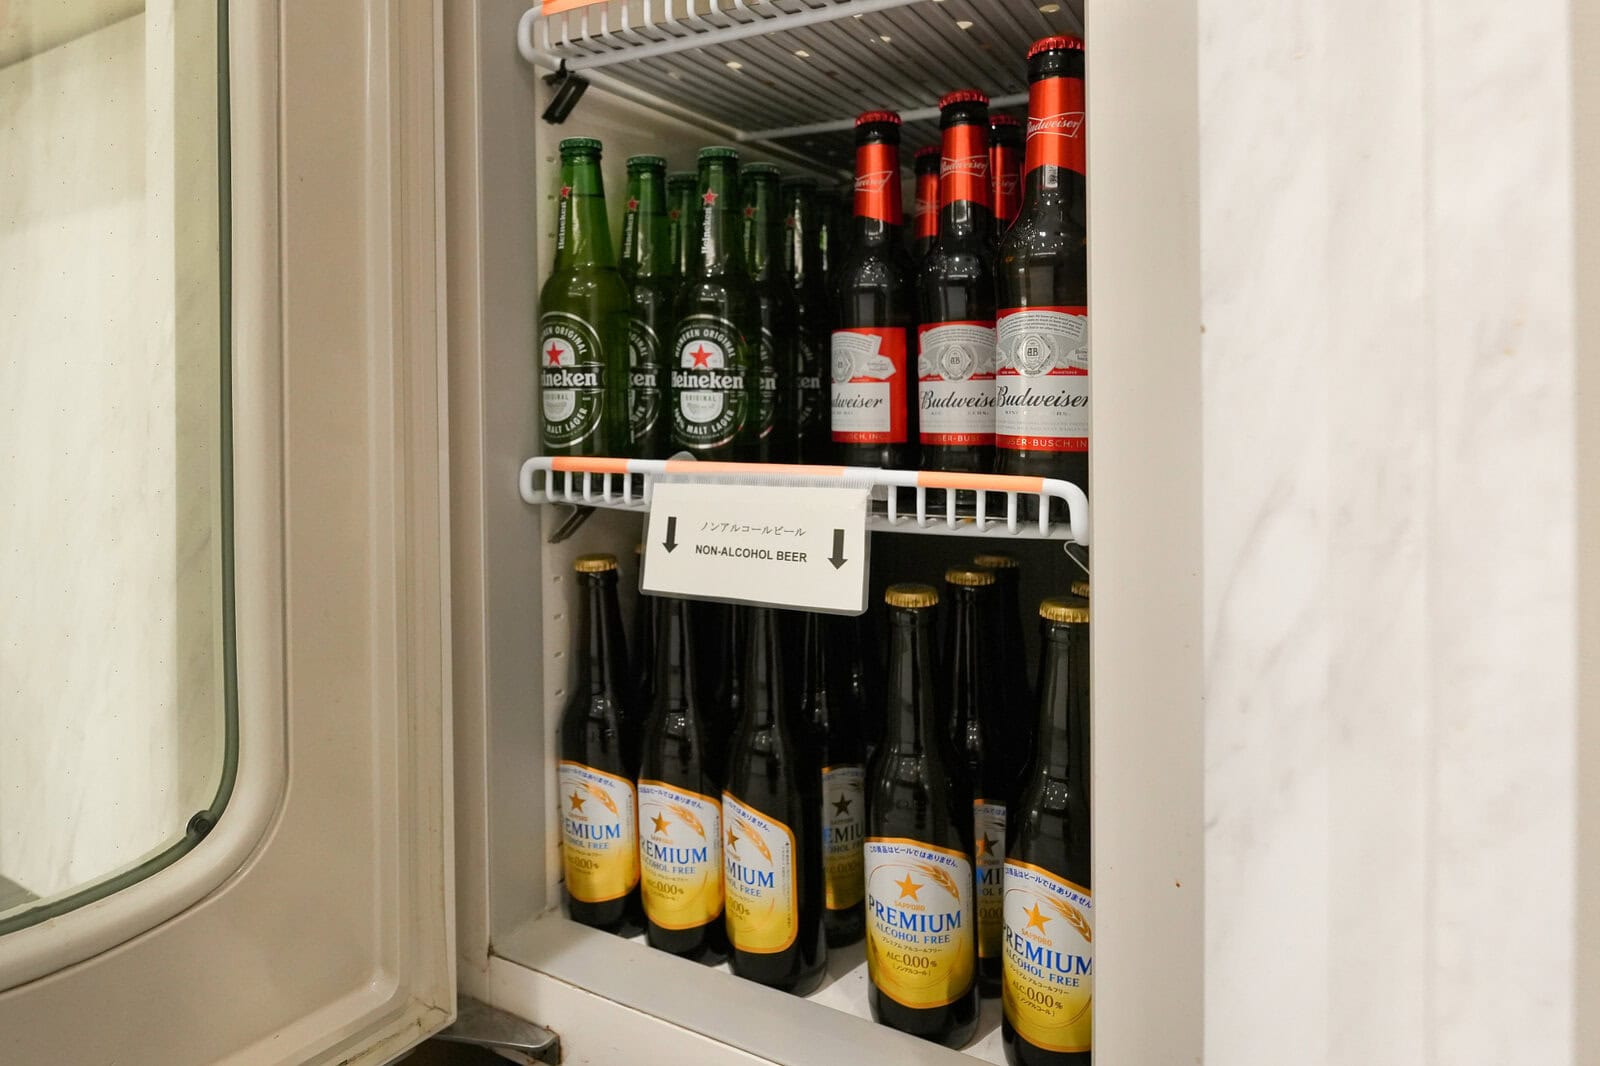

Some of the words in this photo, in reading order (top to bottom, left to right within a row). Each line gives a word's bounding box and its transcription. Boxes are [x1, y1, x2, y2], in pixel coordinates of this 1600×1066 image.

[558, 201, 567, 249] Heineken
[701, 207, 712, 255] Heineken
[555, 326, 588, 355] ORIGINAL
[703, 329, 736, 358] ORIGINAL
[542, 369, 599, 387] ineken
[832, 393, 883, 409] dweiser
[921, 390, 996, 410] Budweise
[686, 424, 708, 435] MALT
[712, 409, 734, 433] LAGER
[700, 521, 807, 537] ノンアルコールビール
[695, 544, 773, 560] NON-ALCOHOL
[776, 551, 807, 563] BEER
[565, 818, 620, 840] EMIUM
[672, 866, 696, 875] FREE
[727, 859, 775, 889] MIUM
[740, 885, 762, 898] FREE
[868, 894, 961, 933] PREMIUM
[875, 922, 920, 944] ALCOHOL
[924, 935, 951, 944] FREE
[1002, 923, 1092, 976] REMIUM
[1049, 973, 1080, 987] FREE
